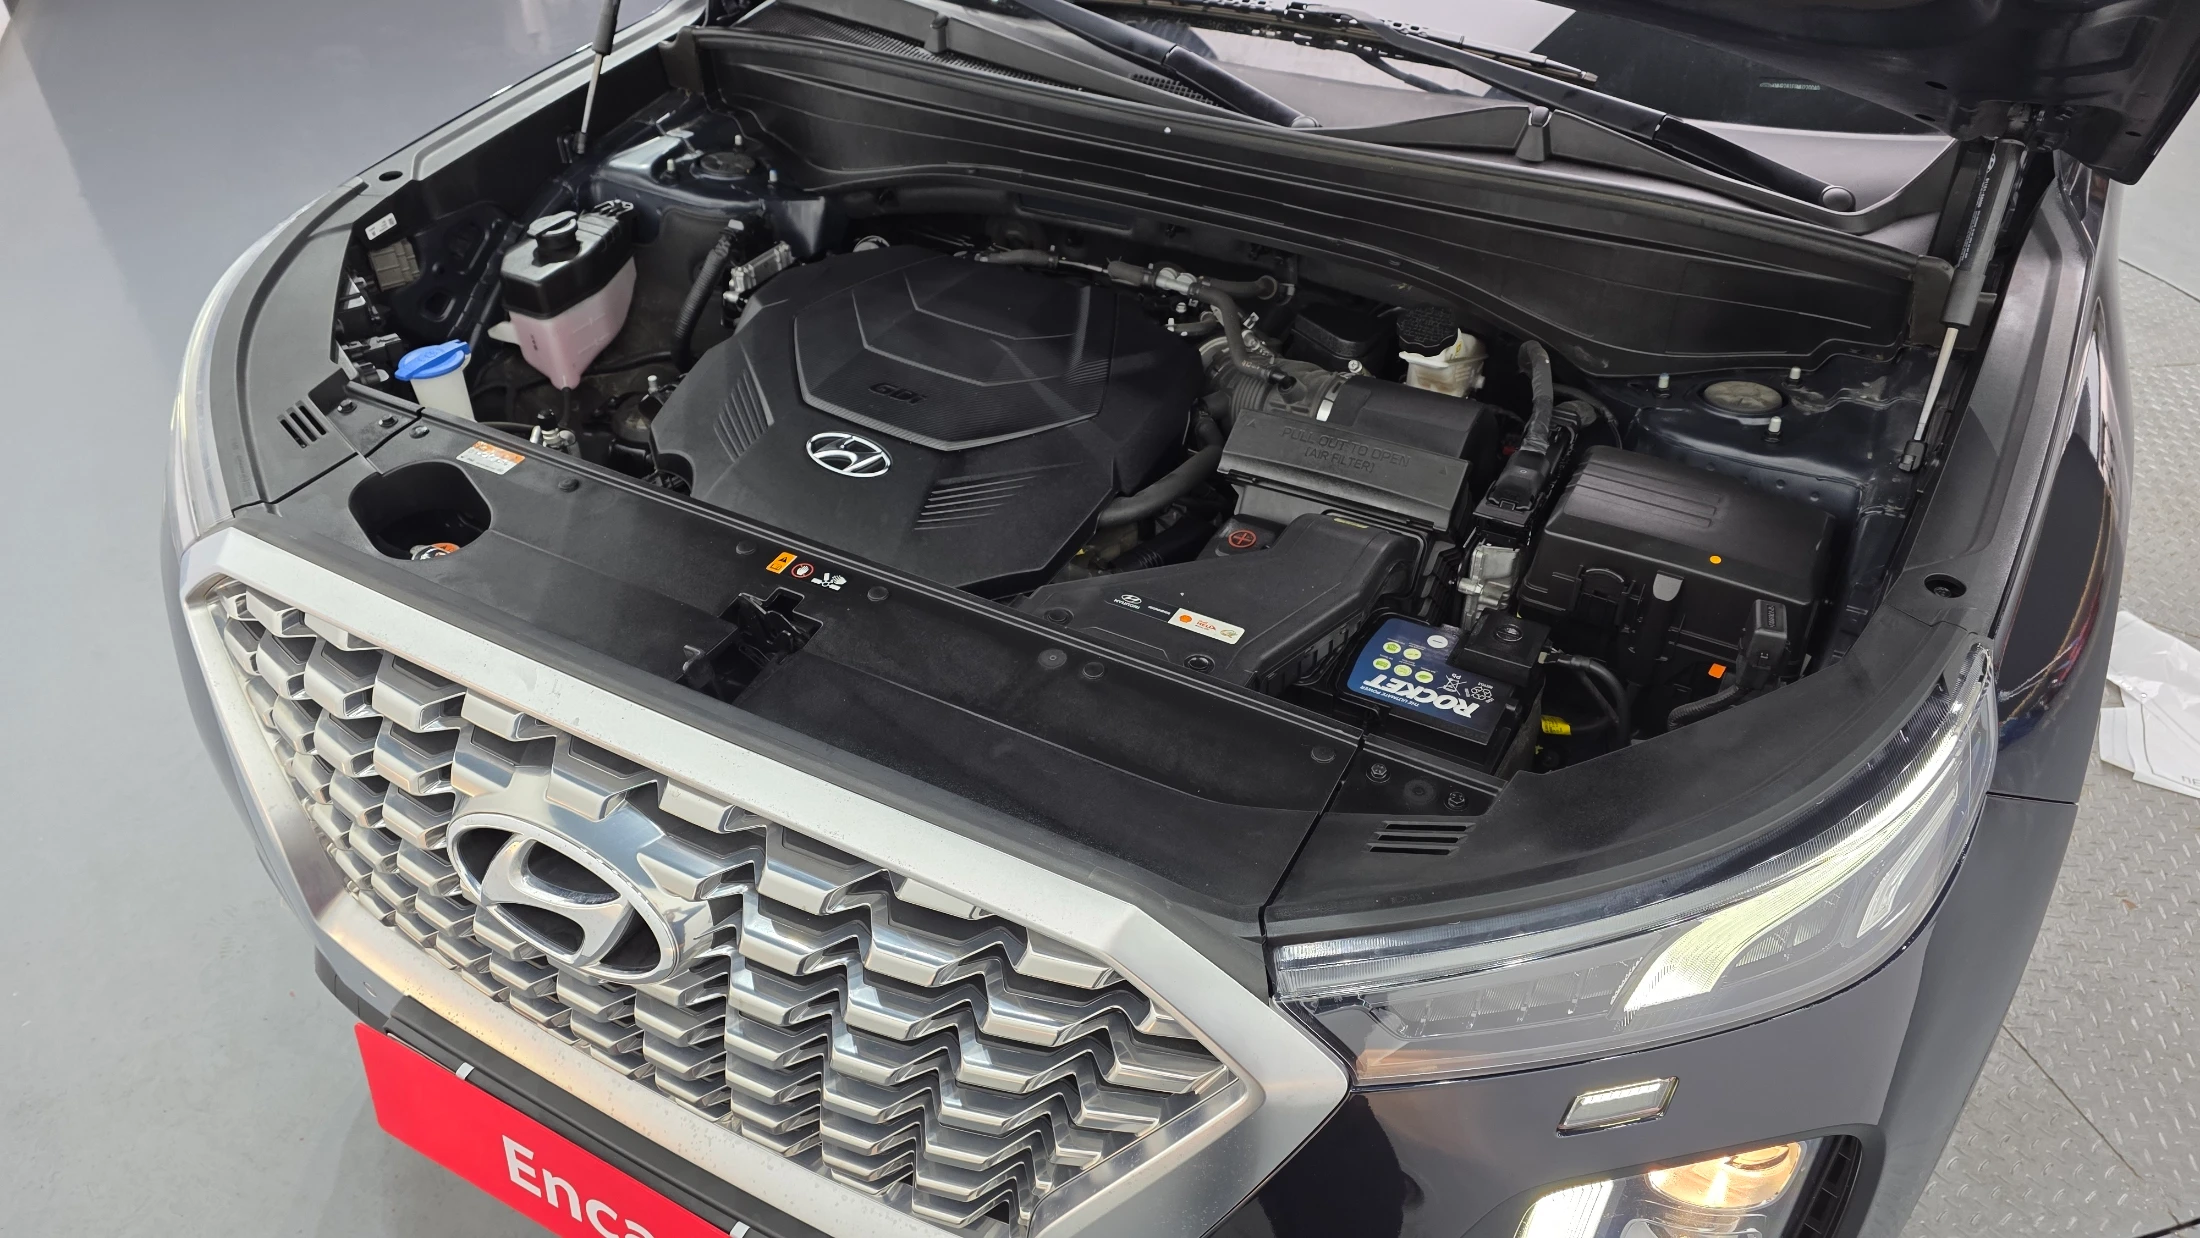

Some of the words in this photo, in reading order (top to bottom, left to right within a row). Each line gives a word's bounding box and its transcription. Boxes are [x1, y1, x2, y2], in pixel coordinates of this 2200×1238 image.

[1281, 426, 1315, 444] PULL
[1318, 435, 1349, 451] OUT
[1350, 441, 1369, 457] TO
[1371, 446, 1412, 468] OPEN
[1359, 685, 1381, 697] POWER
[1362, 673, 1481, 719] ROCKET
[1380, 692, 1408, 705] ULTIMATE
[1407, 700, 1420, 708] THE
